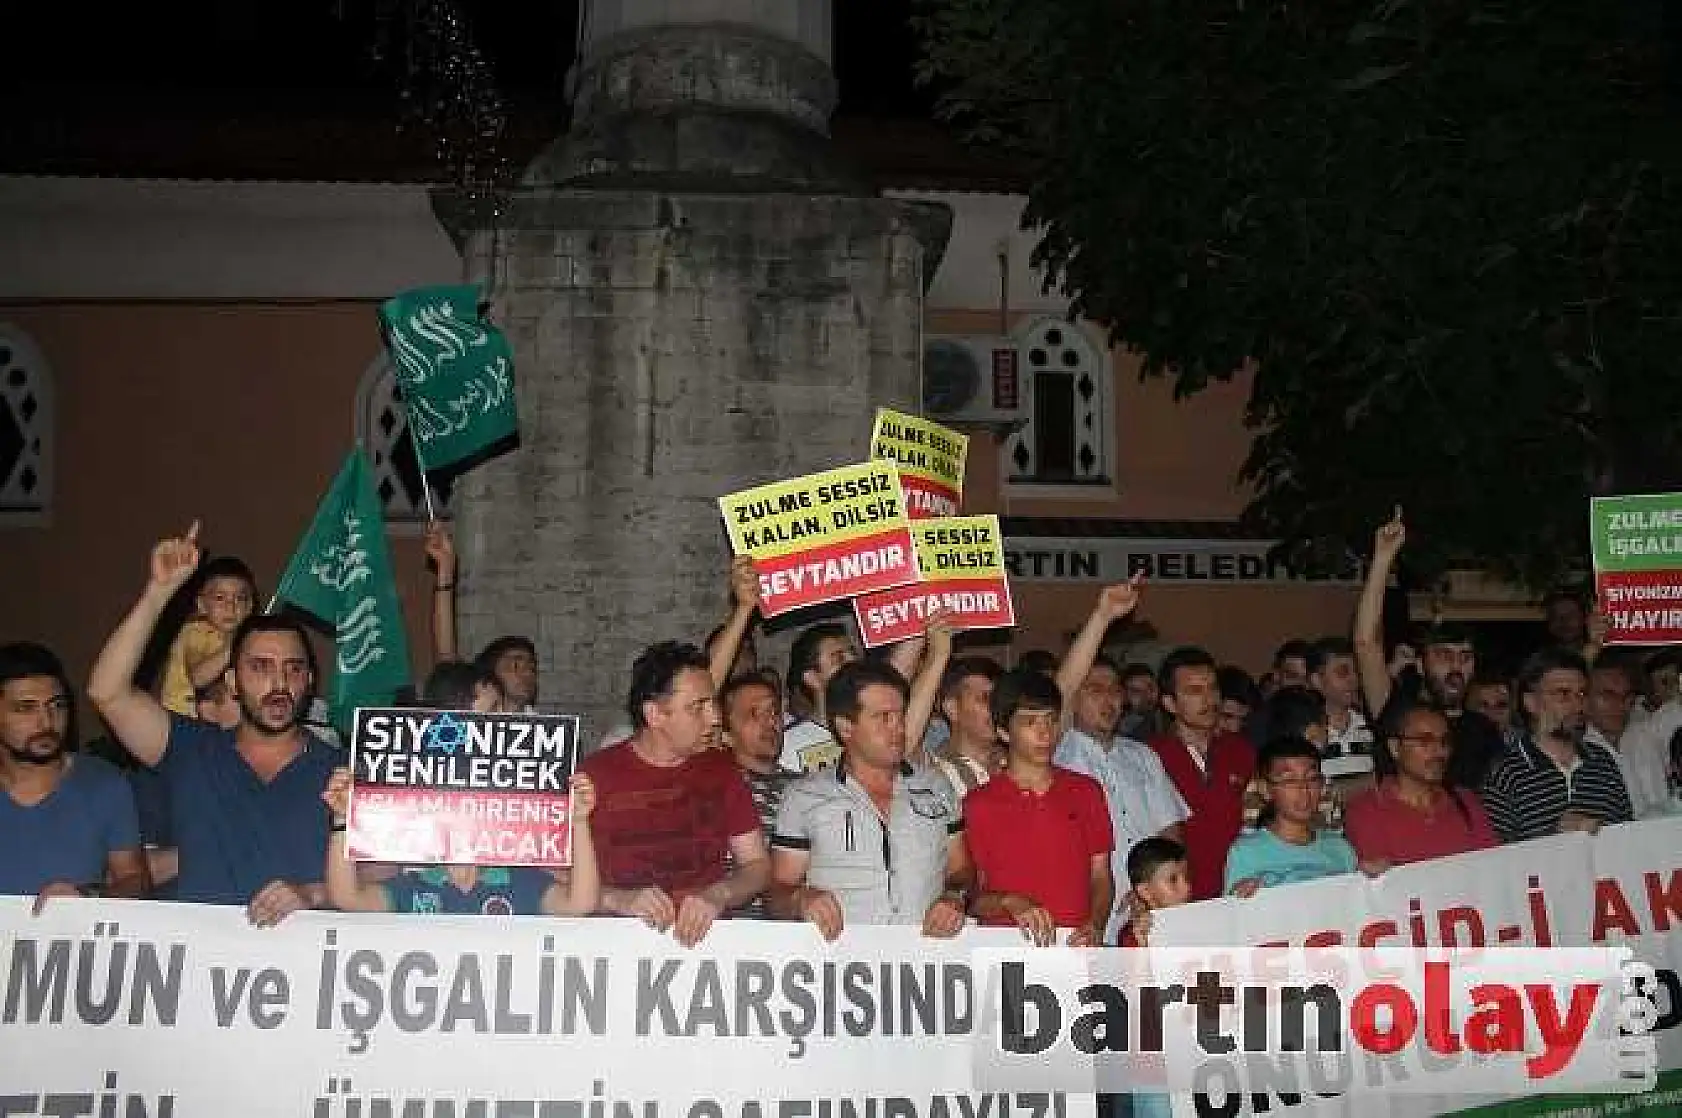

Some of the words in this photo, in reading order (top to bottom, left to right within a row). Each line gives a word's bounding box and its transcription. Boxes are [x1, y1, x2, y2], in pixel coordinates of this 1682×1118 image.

[735, 491, 812, 523] ZULME
[818, 472, 891, 505] SESSİZ
[743, 516, 827, 550] KALAN,
[832, 497, 899, 530] DİLSİZ
[924, 527, 991, 546] SESSİZ
[935, 548, 997, 569] DİLSİZ
[363, 751, 564, 790] YENİLECEK
[2, 921, 187, 1026] MÜN
[210, 966, 291, 1030] ve
[315, 928, 610, 1054] İŞGALİN
[634, 957, 998, 1059] KARŞISIND
